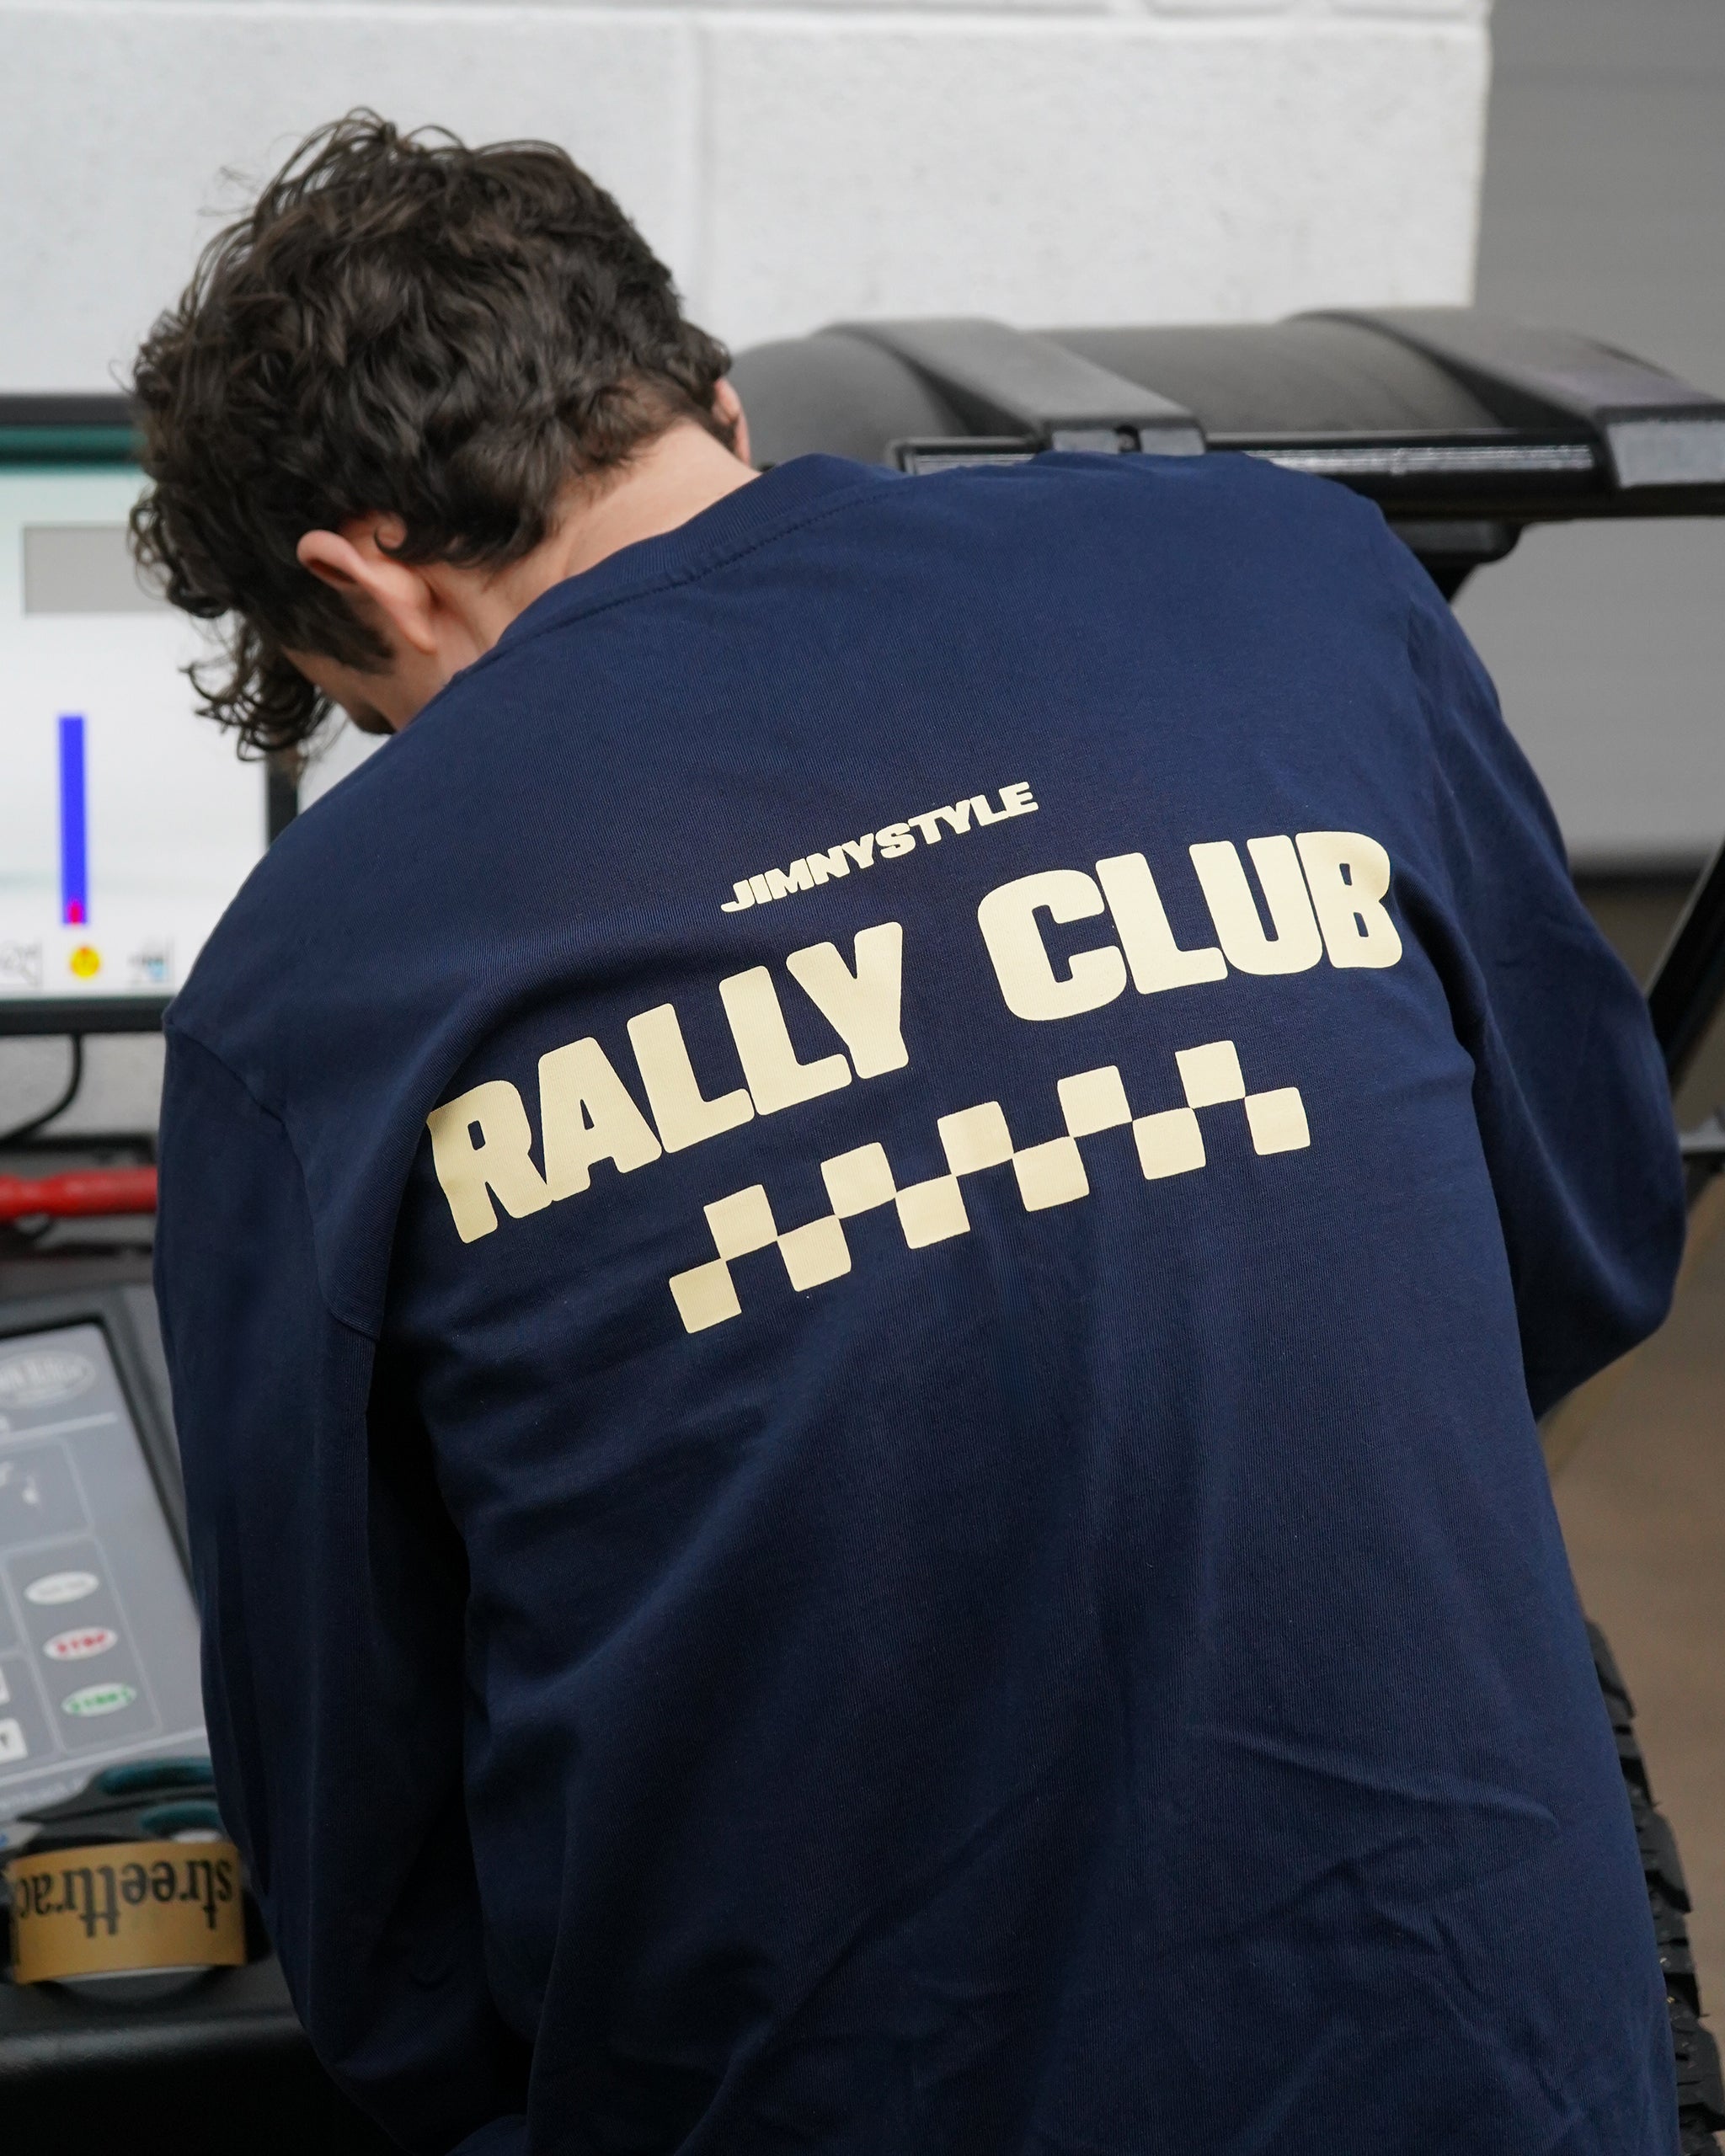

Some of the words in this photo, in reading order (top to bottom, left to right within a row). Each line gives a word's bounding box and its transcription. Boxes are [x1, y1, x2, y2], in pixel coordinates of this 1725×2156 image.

[720, 781, 1039, 913] JIMNYSTYLE
[427, 921, 910, 1243] RALLY
[977, 830, 1403, 1022] CLUB
